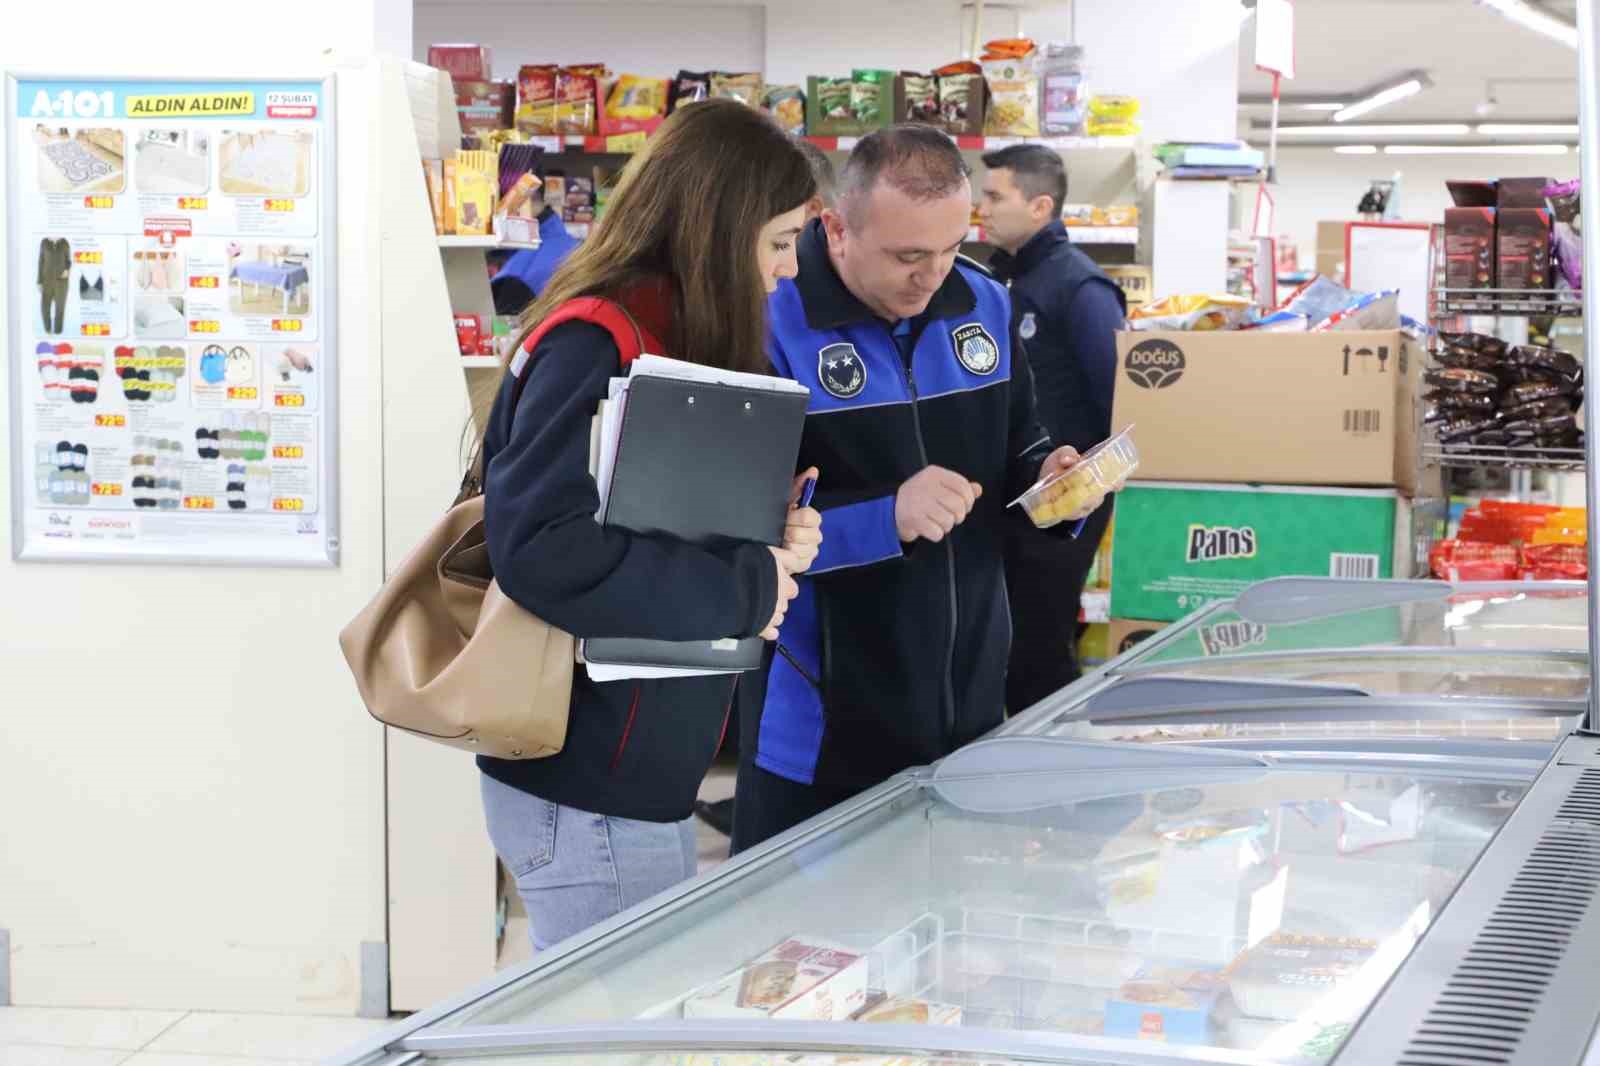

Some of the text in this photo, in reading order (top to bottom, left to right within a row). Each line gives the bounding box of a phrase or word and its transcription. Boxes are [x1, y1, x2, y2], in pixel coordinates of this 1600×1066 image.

[133, 97, 248, 113] ALDIN ALDIN!
[1131, 347, 1180, 366] DOĞUŞ
